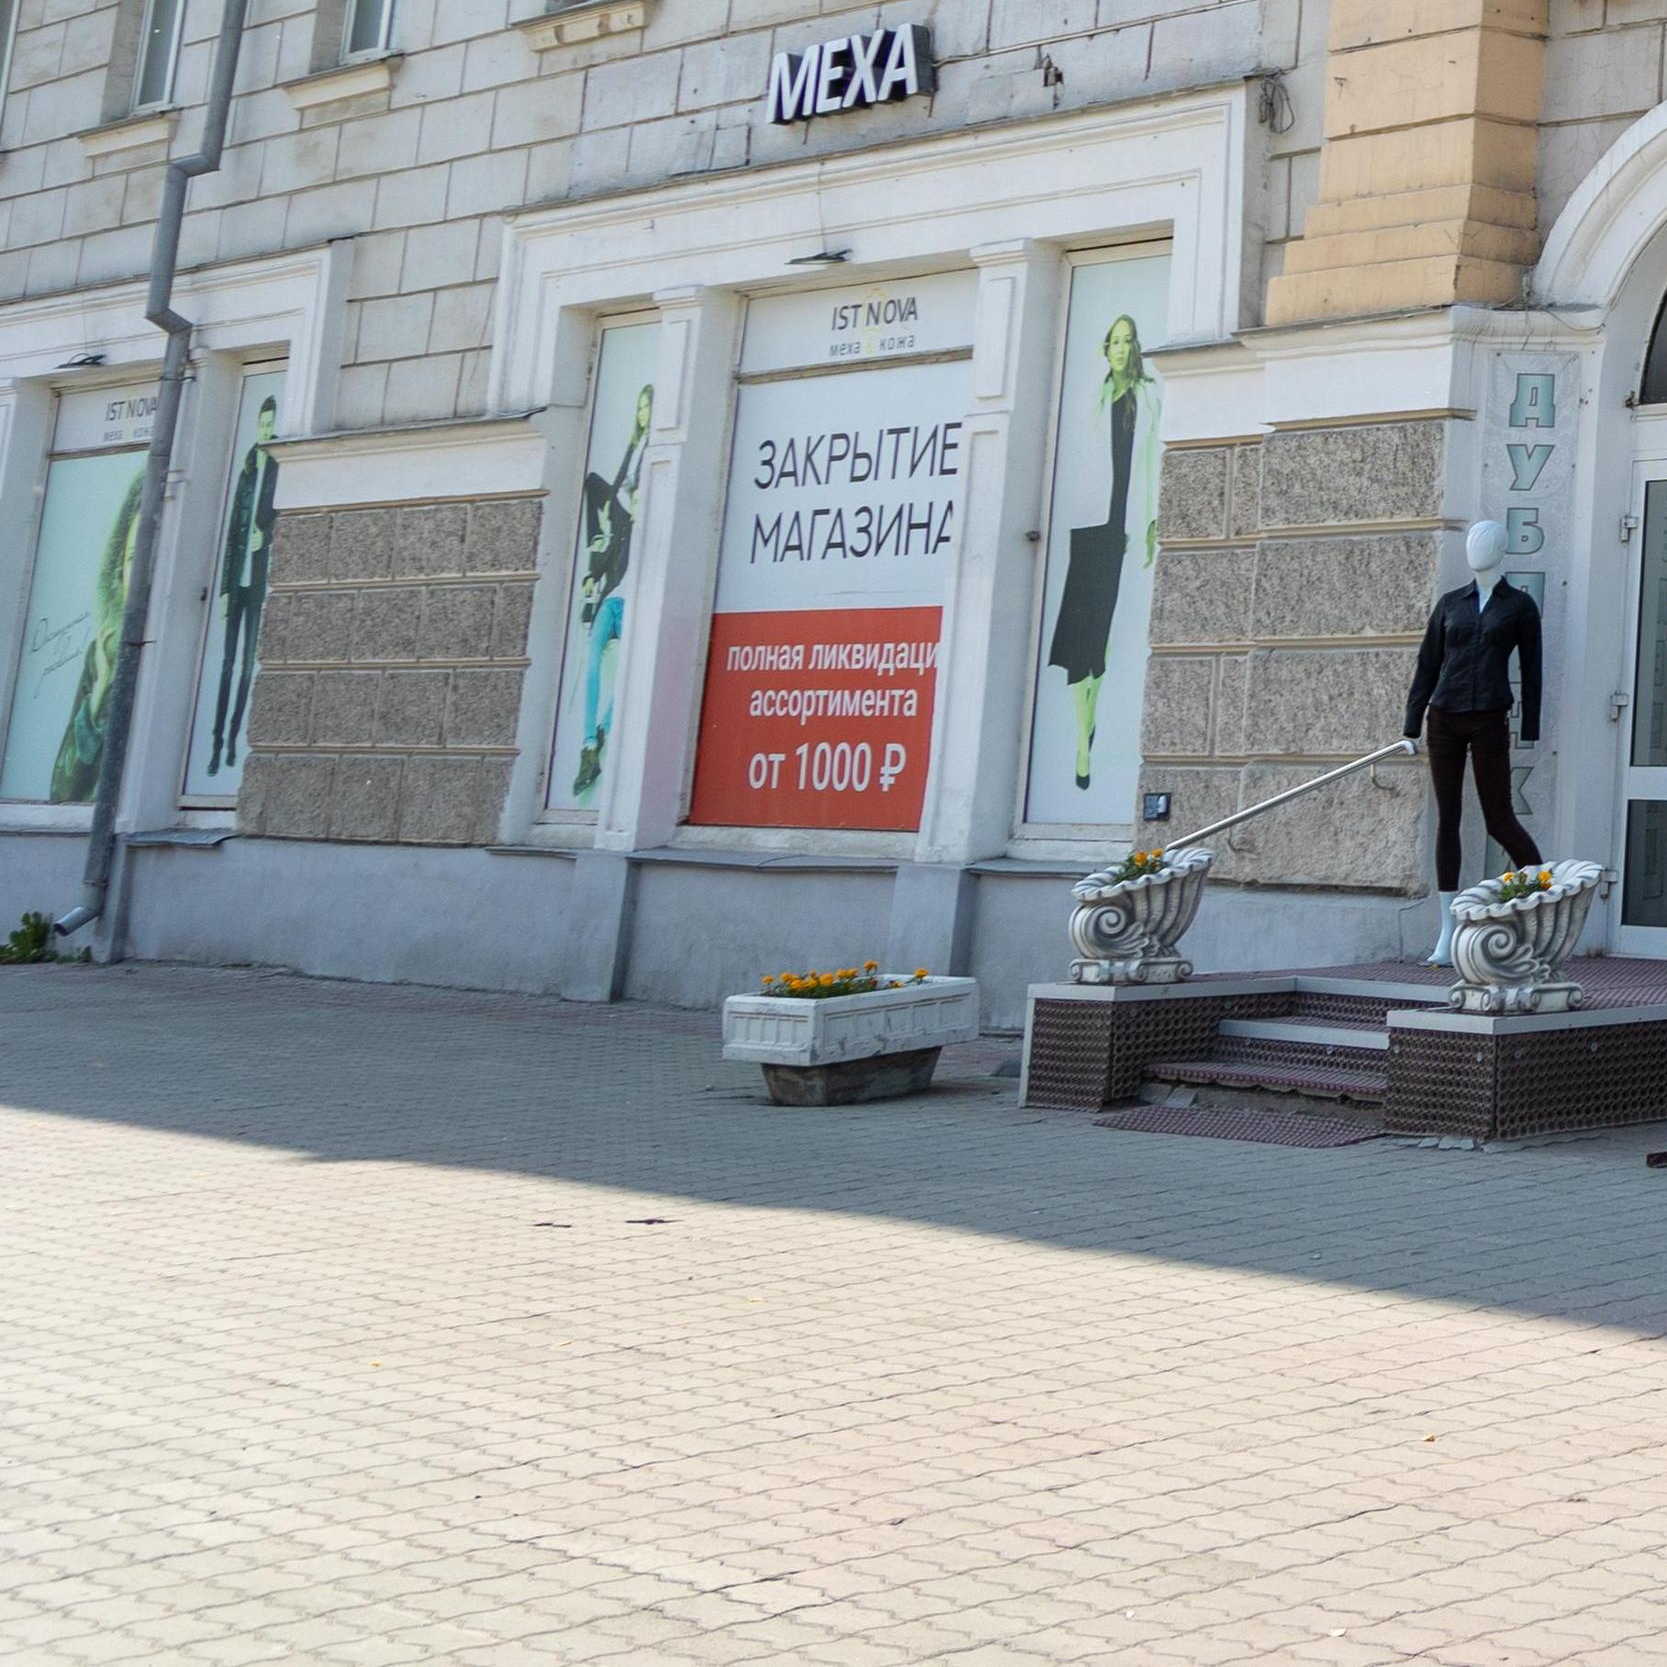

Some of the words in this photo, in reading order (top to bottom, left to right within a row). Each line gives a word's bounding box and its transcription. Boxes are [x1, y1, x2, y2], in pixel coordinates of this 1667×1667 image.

[766, 22, 920, 124] МЕХА
[831, 304, 862, 331] IST
[865, 297, 918, 326] NOVA
[754, 422, 962, 489] ЗАКРЫТИЕ
[750, 500, 953, 564] МАГАЗИНА
[727, 644, 805, 671] полная
[750, 689, 918, 726] ассортимента
[749, 753, 786, 789] от
[795, 742, 872, 792] 1000
